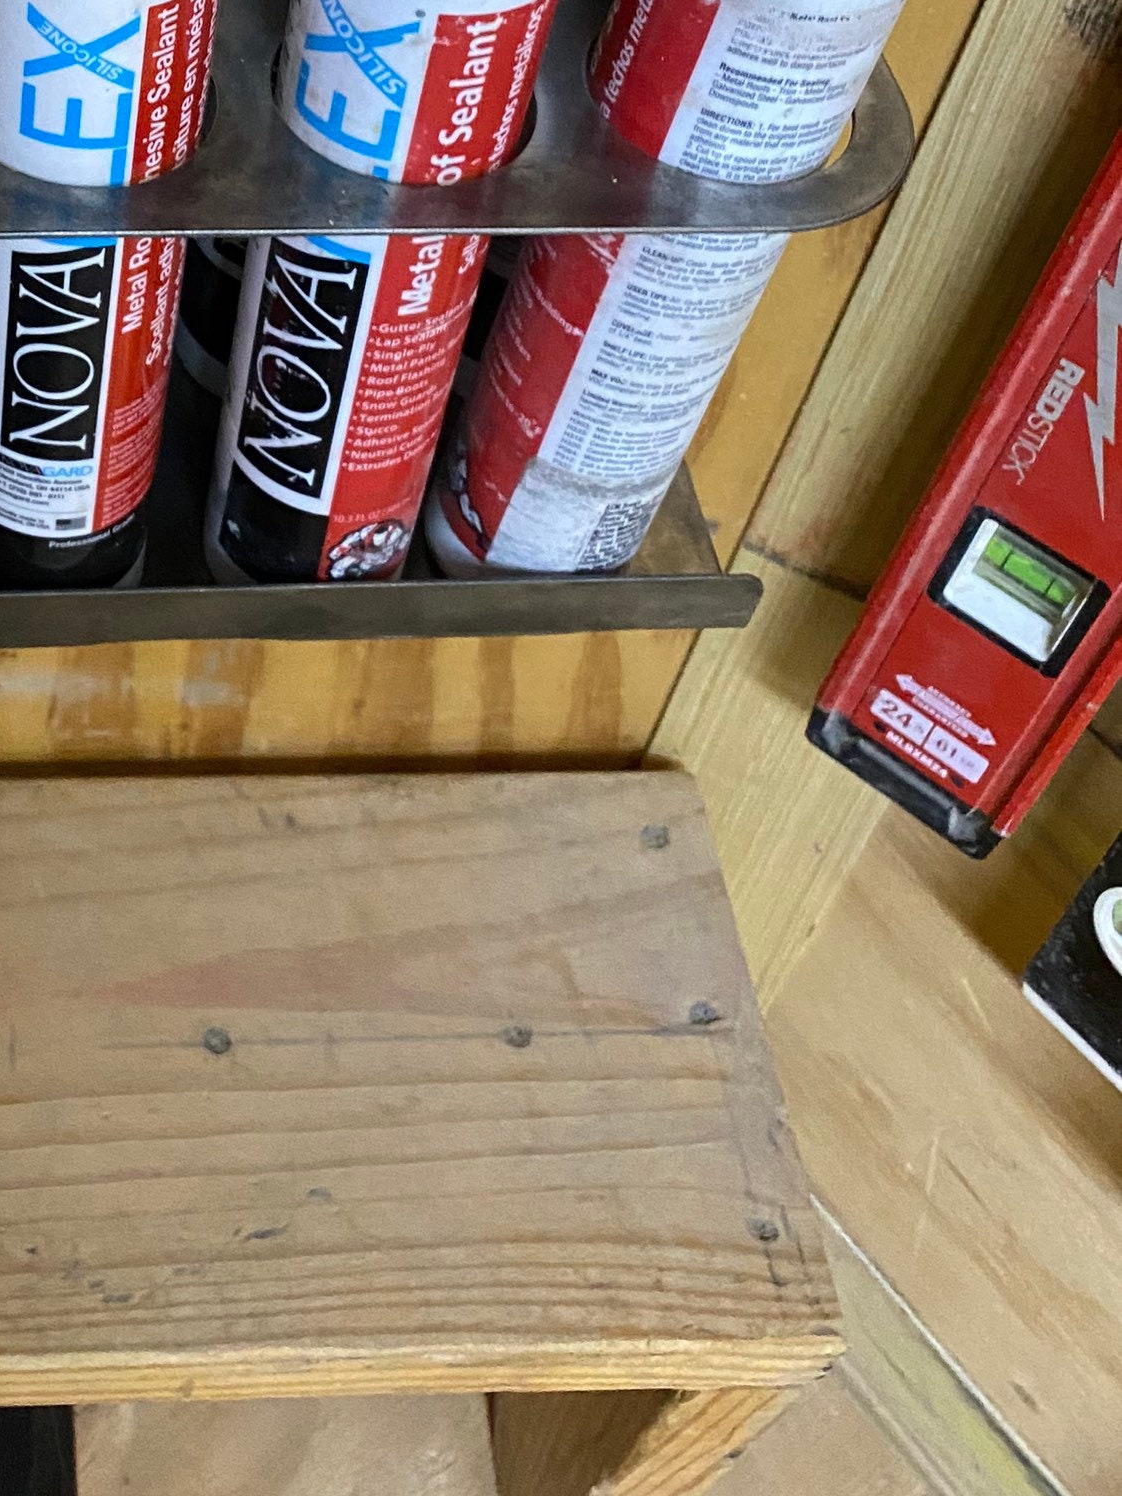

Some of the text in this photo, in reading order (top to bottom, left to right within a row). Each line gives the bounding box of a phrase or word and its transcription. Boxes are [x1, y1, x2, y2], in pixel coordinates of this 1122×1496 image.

[37, 18, 123, 81] SILICONE
[183, 56, 201, 93] en
[602, 37, 635, 104] techos
[718, 61, 784, 87] Recommended
[784, 78, 798, 88] For
[721, 73, 745, 87] Metal
[139, 3, 180, 185] hesive Sealant
[429, 13, 509, 187] of Sealant
[699, 107, 755, 130] DIRECTIONS:
[766, 123, 781, 132] For
[718, 123, 743, 137] down
[753, 130, 768, 139] the
[692, 123, 714, 137] from
[713, 131, 732, 144] any
[729, 136, 763, 149] material
[763, 139, 779, 149] that
[681, 149, 767, 175] and place cartridge
[695, 144, 710, 155] Cut
[121, 237, 153, 335] Metal Ro
[397, 235, 446, 318] Metal
[626, 283, 649, 297] USER
[145, 279, 171, 366] Scellant
[375, 322, 448, 348] Lap Sealant
[378, 322, 421, 334] Gutter
[8, 247, 107, 451] NOVA
[602, 339, 628, 354] SHELF
[243, 253, 359, 488] NOVA
[366, 357, 447, 386] Roof Flashing
[369, 361, 408, 373] Metal
[590, 367, 608, 380] MAX
[361, 383, 438, 411] Snow Guards
[363, 379, 429, 400] Pipe Boots
[1001, 357, 1086, 471] REDSTICK
[352, 430, 410, 448] Adhesive
[347, 456, 402, 473] Extrudes
[349, 447, 398, 460] Neutral
[880, 698, 914, 729] 24
